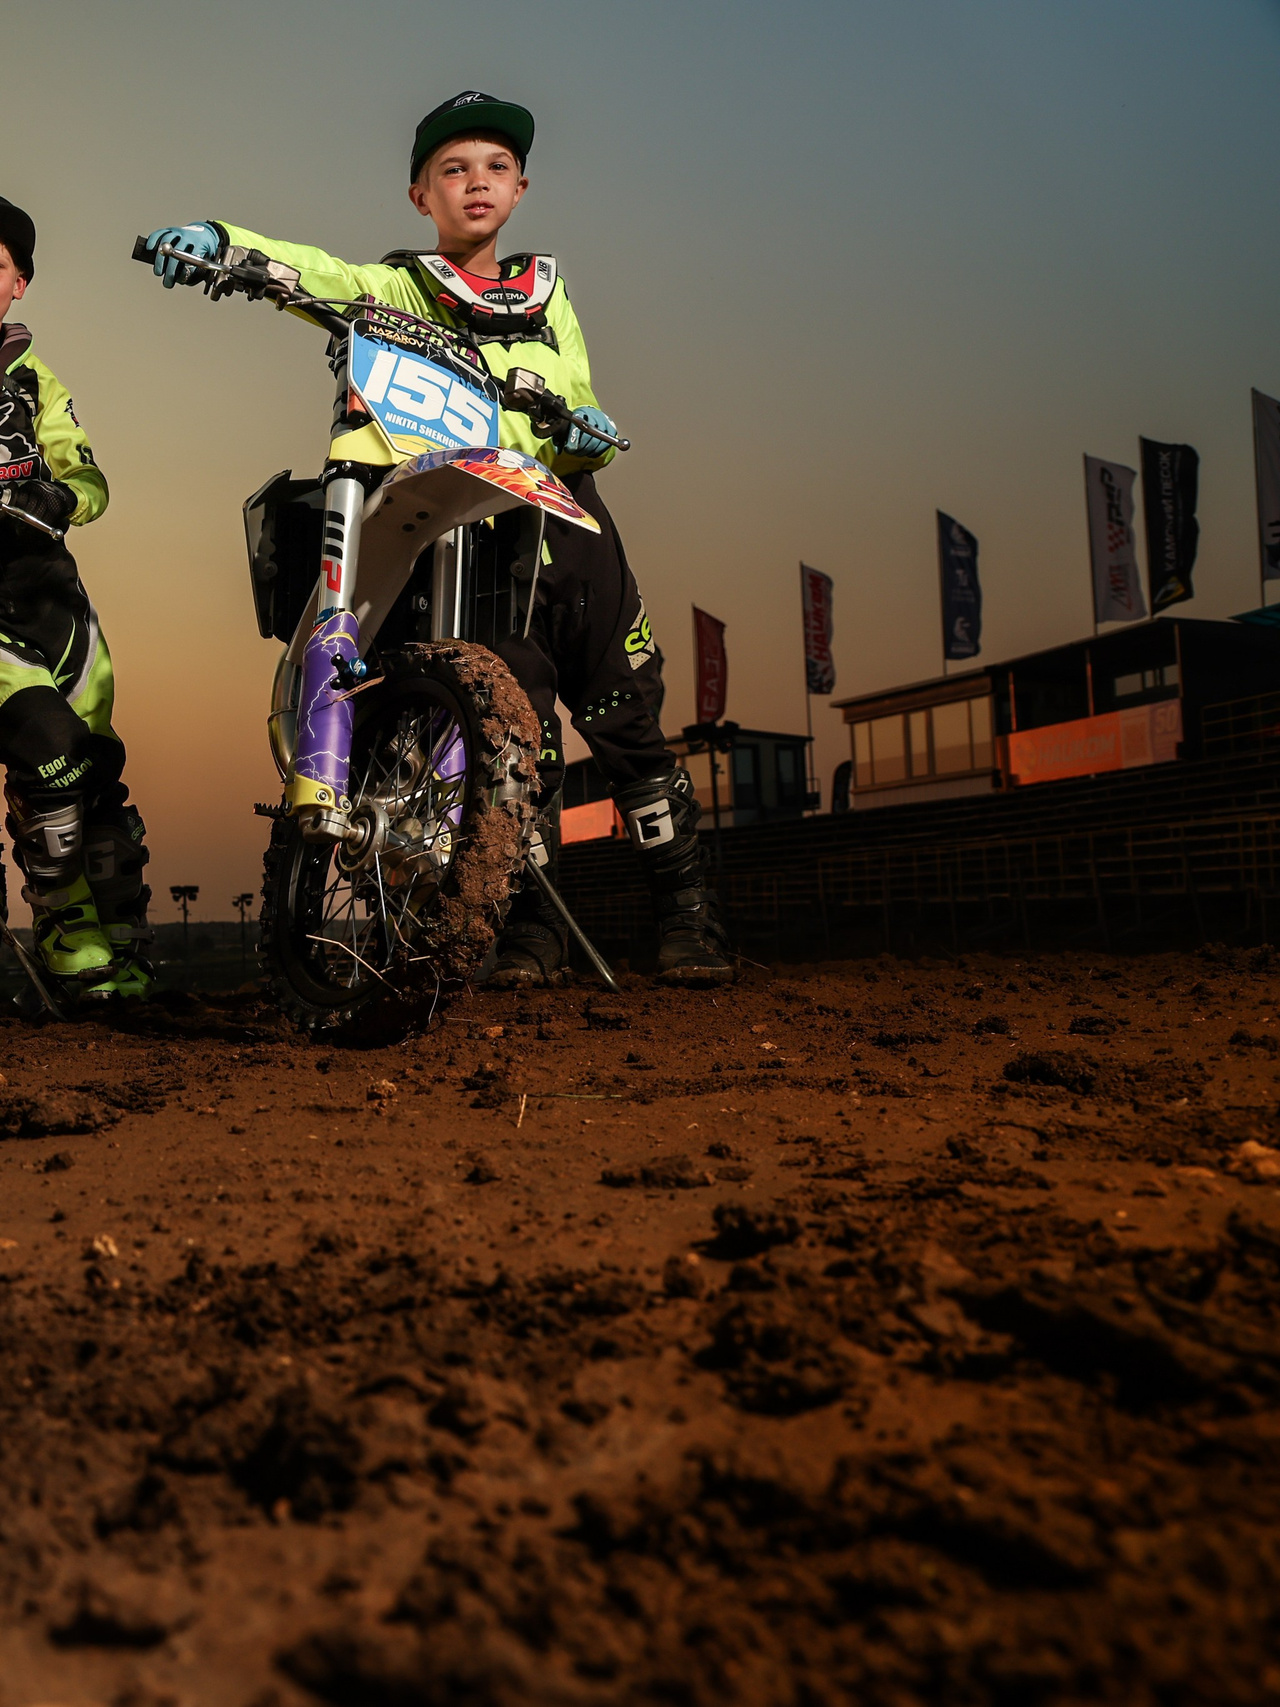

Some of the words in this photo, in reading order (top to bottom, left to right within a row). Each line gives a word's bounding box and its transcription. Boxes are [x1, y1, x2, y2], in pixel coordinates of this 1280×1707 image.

[483, 292, 526, 301] ORTEMA
[368, 324, 425, 348] NAZAROV
[362, 350, 494, 448] 155
[384, 412, 418, 432] NIKITA
[38, 755, 68, 779] Egor
[48, 757, 93, 789] styakov
